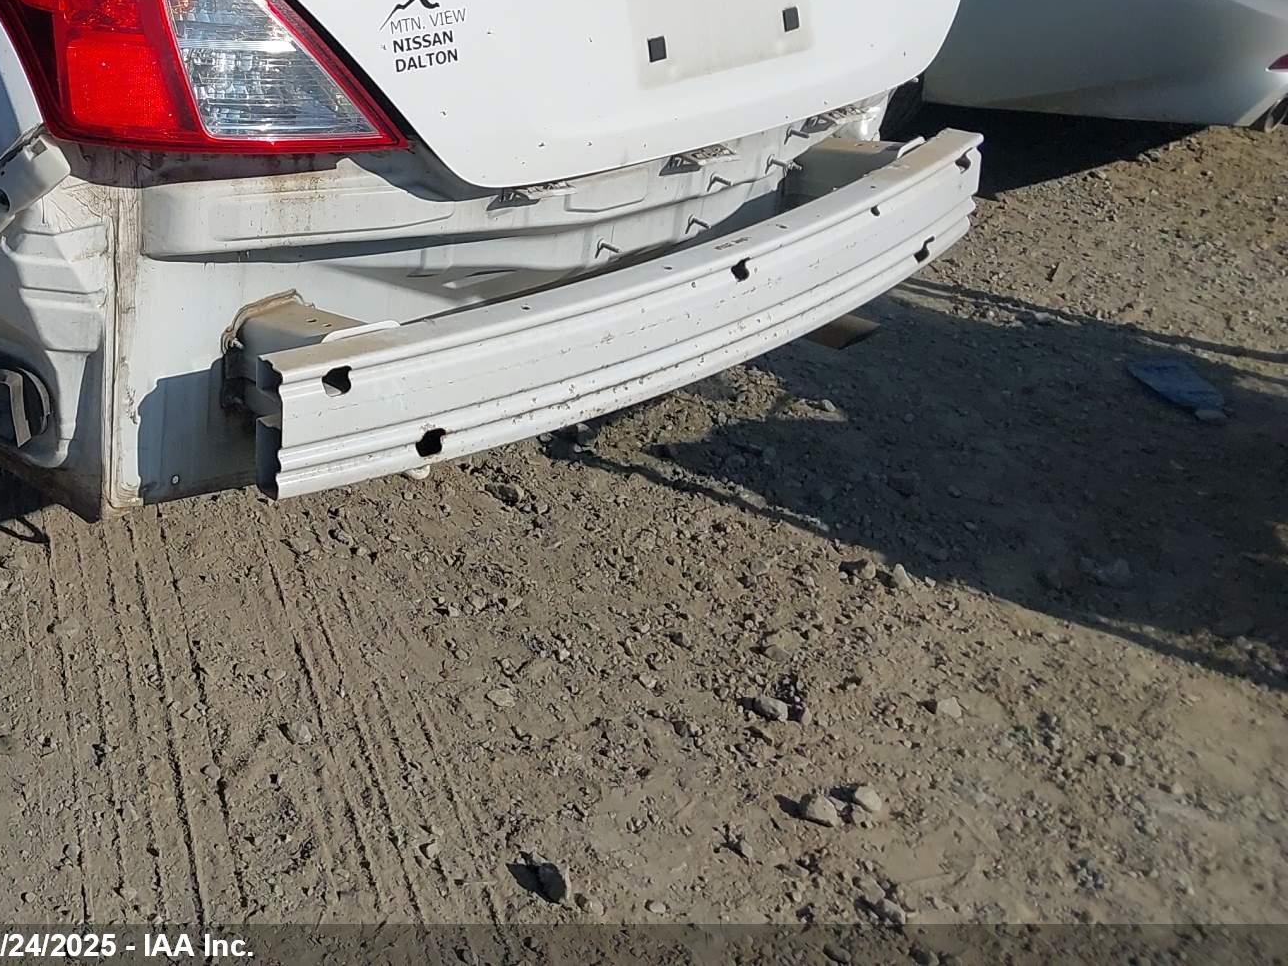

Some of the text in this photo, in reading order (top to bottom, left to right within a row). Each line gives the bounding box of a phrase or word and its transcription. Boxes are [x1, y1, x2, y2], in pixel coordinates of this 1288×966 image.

[390, 7, 467, 35] MTN. VIEW
[393, 30, 454, 54] NISSAN
[395, 49, 459, 73] DALTON
